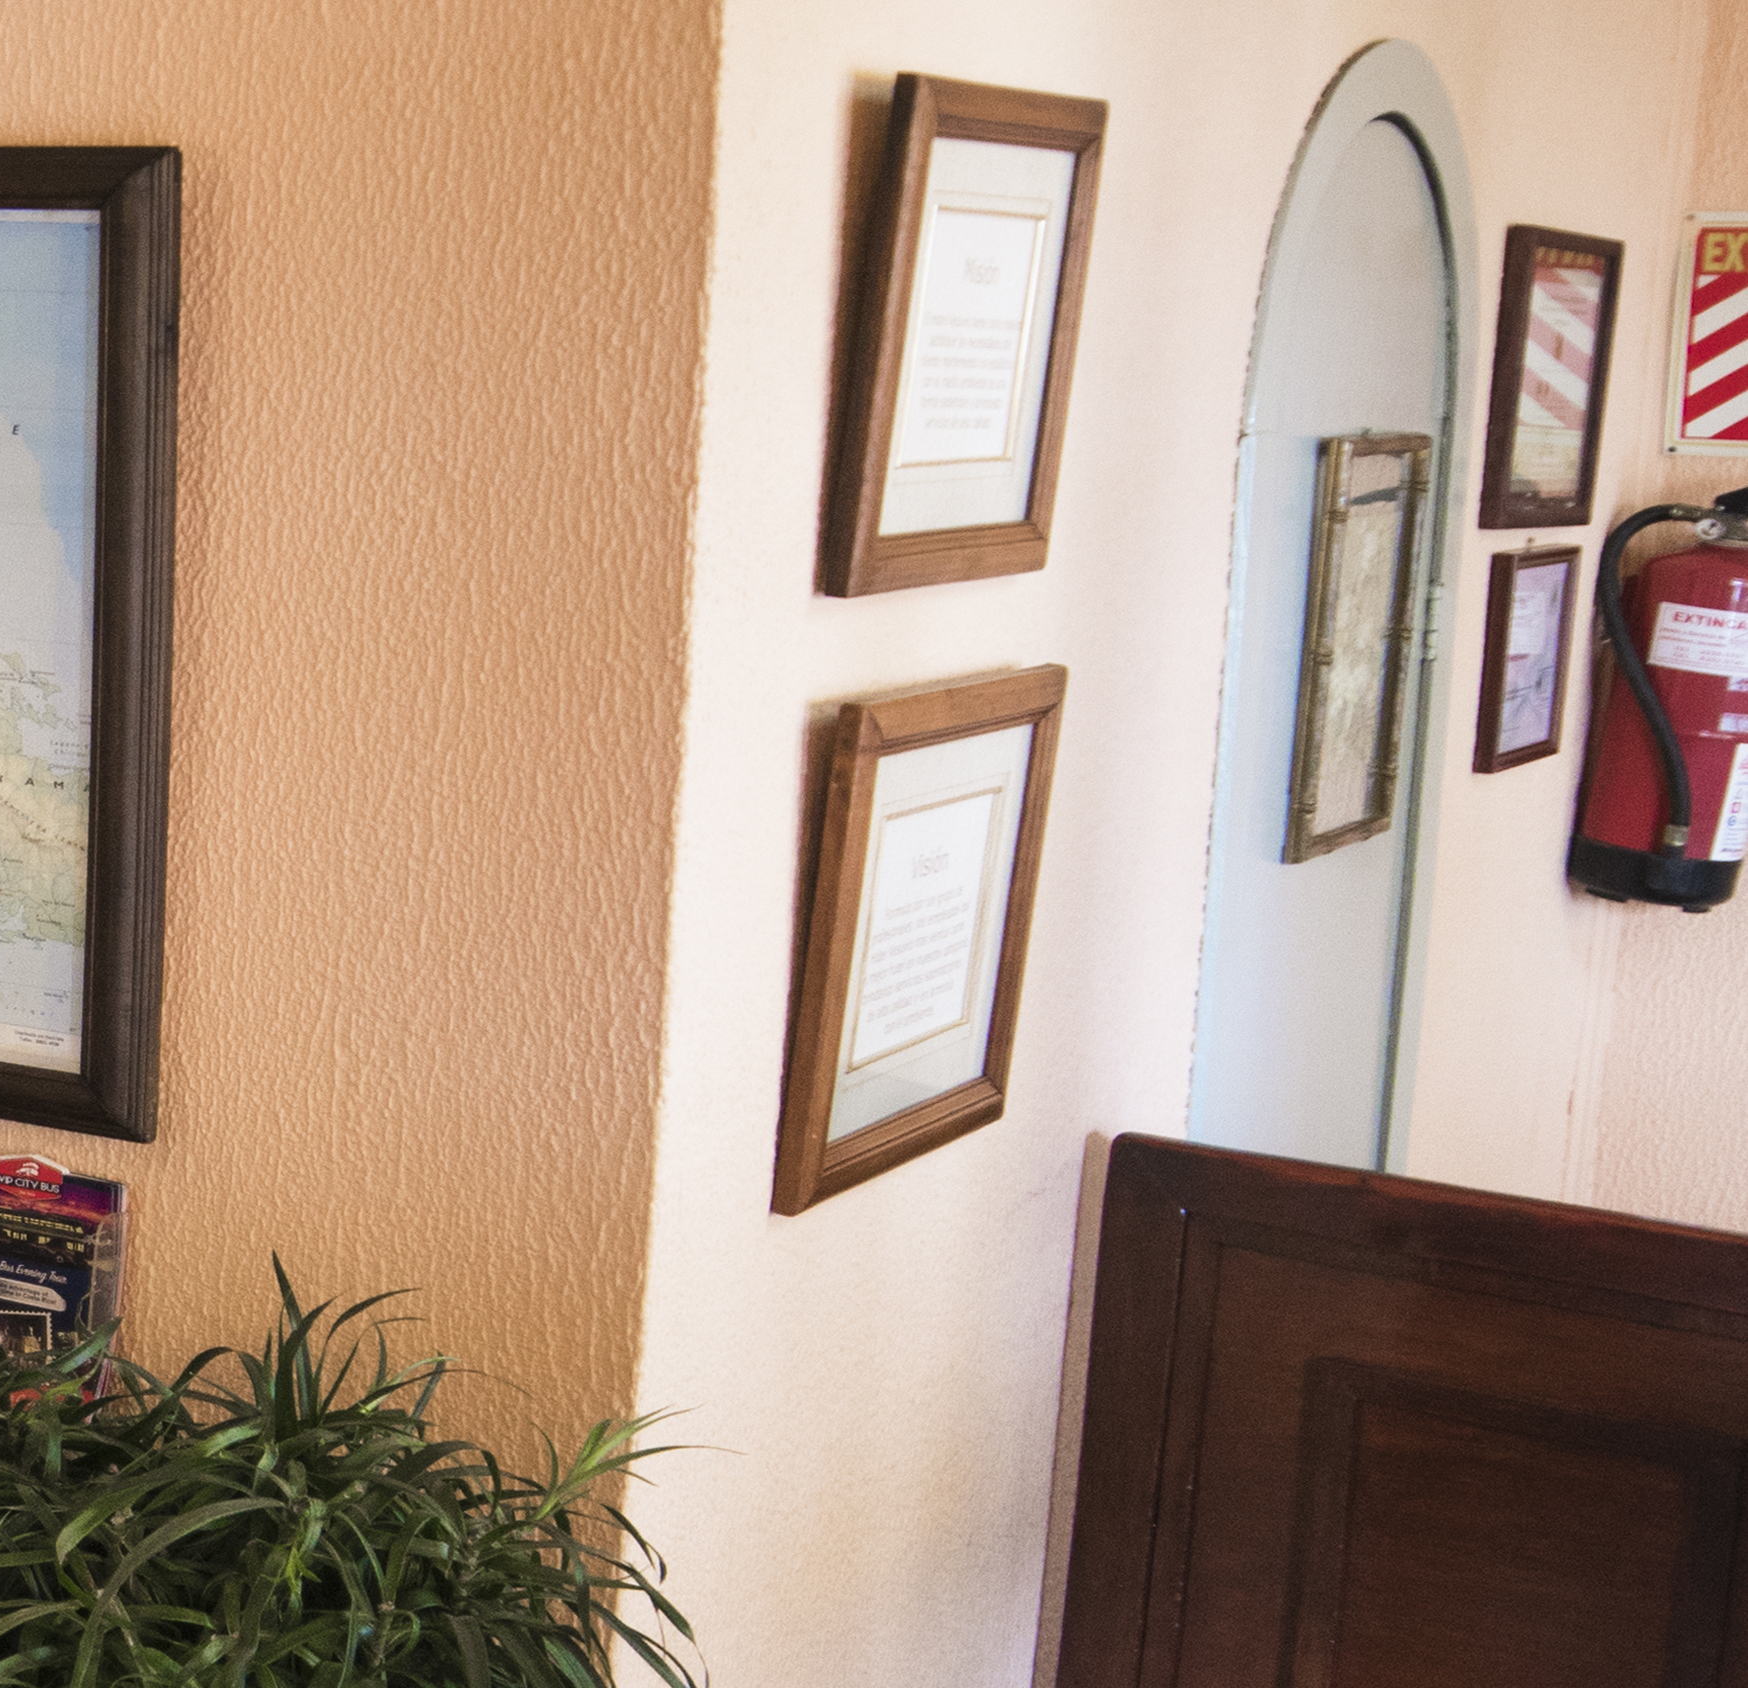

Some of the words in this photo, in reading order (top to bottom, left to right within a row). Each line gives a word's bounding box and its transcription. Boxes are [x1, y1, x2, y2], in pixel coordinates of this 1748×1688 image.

[1703, 233, 1747, 272] EX
[14, 1177, 39, 1189] CITY
[40, 1181, 60, 1194] BUS
[0, 1260, 14, 1273] Bus
[15, 1264, 47, 1284] Evening
[48, 1271, 68, 1285] Tour
[0, 1288, 15, 1297] time
[22, 1291, 40, 1301] Costa
[9, 1282, 37, 1297] advantage
